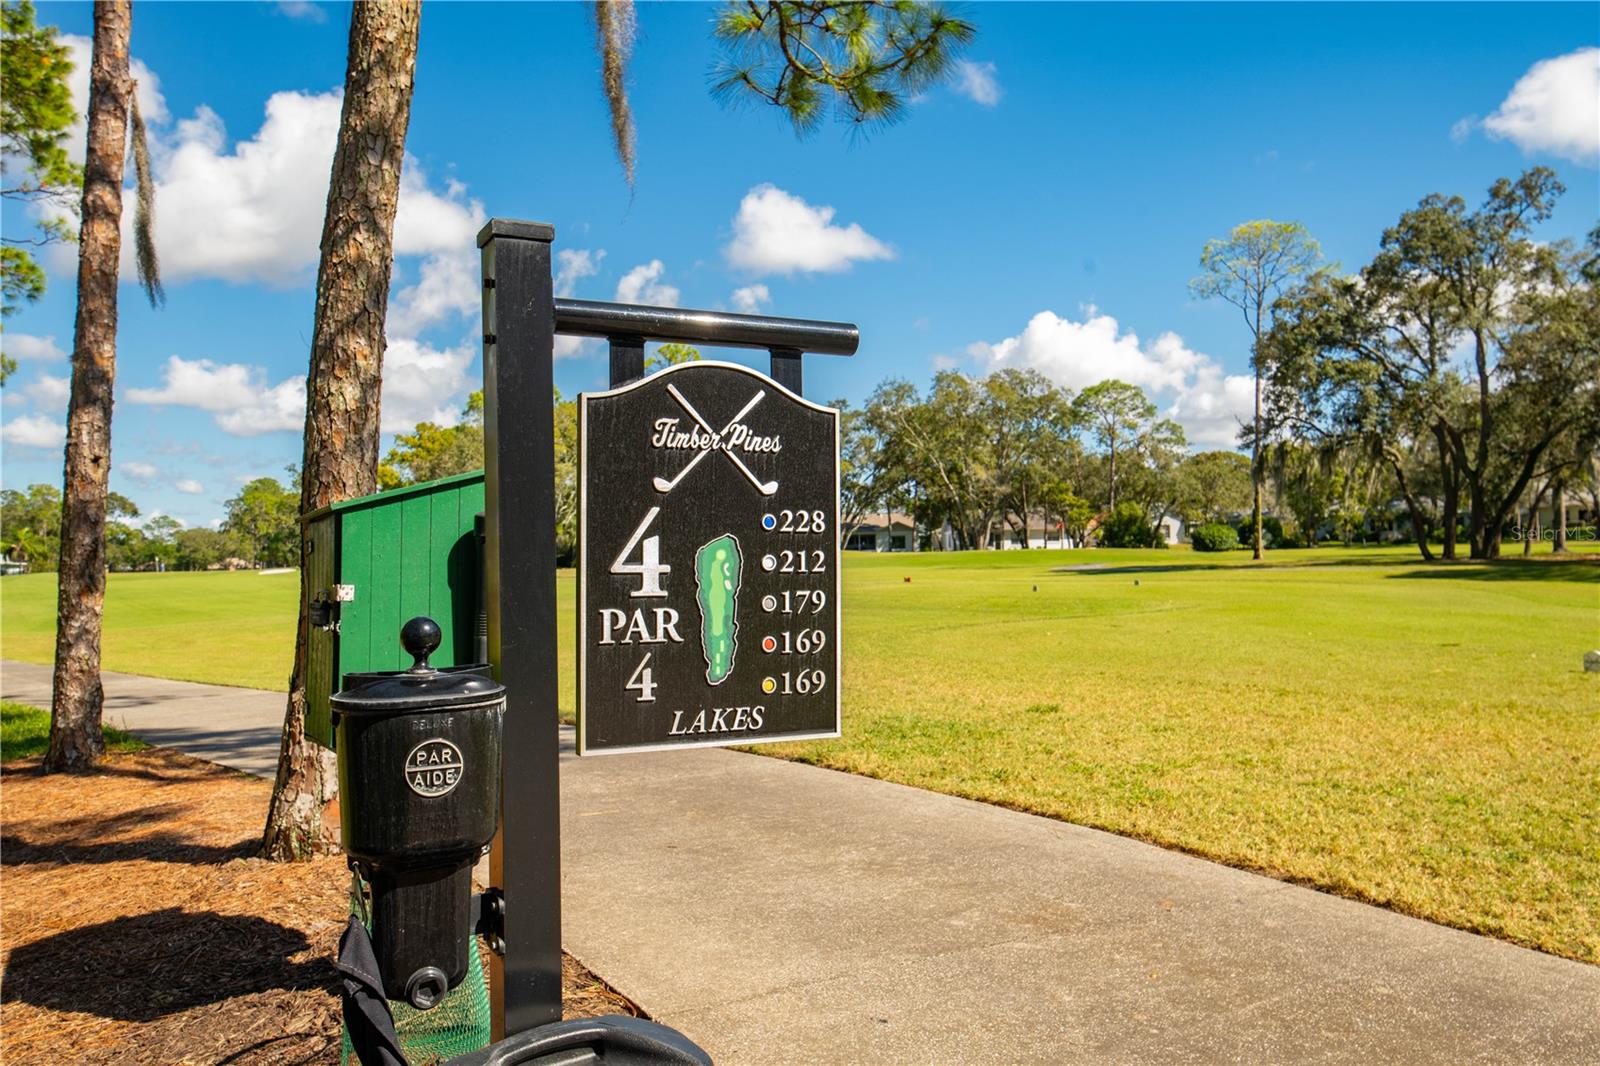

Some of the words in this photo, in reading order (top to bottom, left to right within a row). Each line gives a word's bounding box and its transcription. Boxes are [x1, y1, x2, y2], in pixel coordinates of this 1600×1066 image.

[652, 417, 722, 450] Timber
[727, 422, 782, 453] Pines
[779, 509, 826, 533] 228
[610, 506, 671, 597] 4
[779, 549, 826, 573] 212
[781, 589, 826, 614] 179
[598, 607, 685, 644] PAR
[781, 629, 826, 654] 169
[625, 652, 658, 702] 4
[781, 669, 826, 695] 169
[412, 717, 454, 730] DELUXE
[668, 705, 765, 736] LAKES
[416, 748, 452, 766] PAR
[413, 768, 457, 787] AIDE
